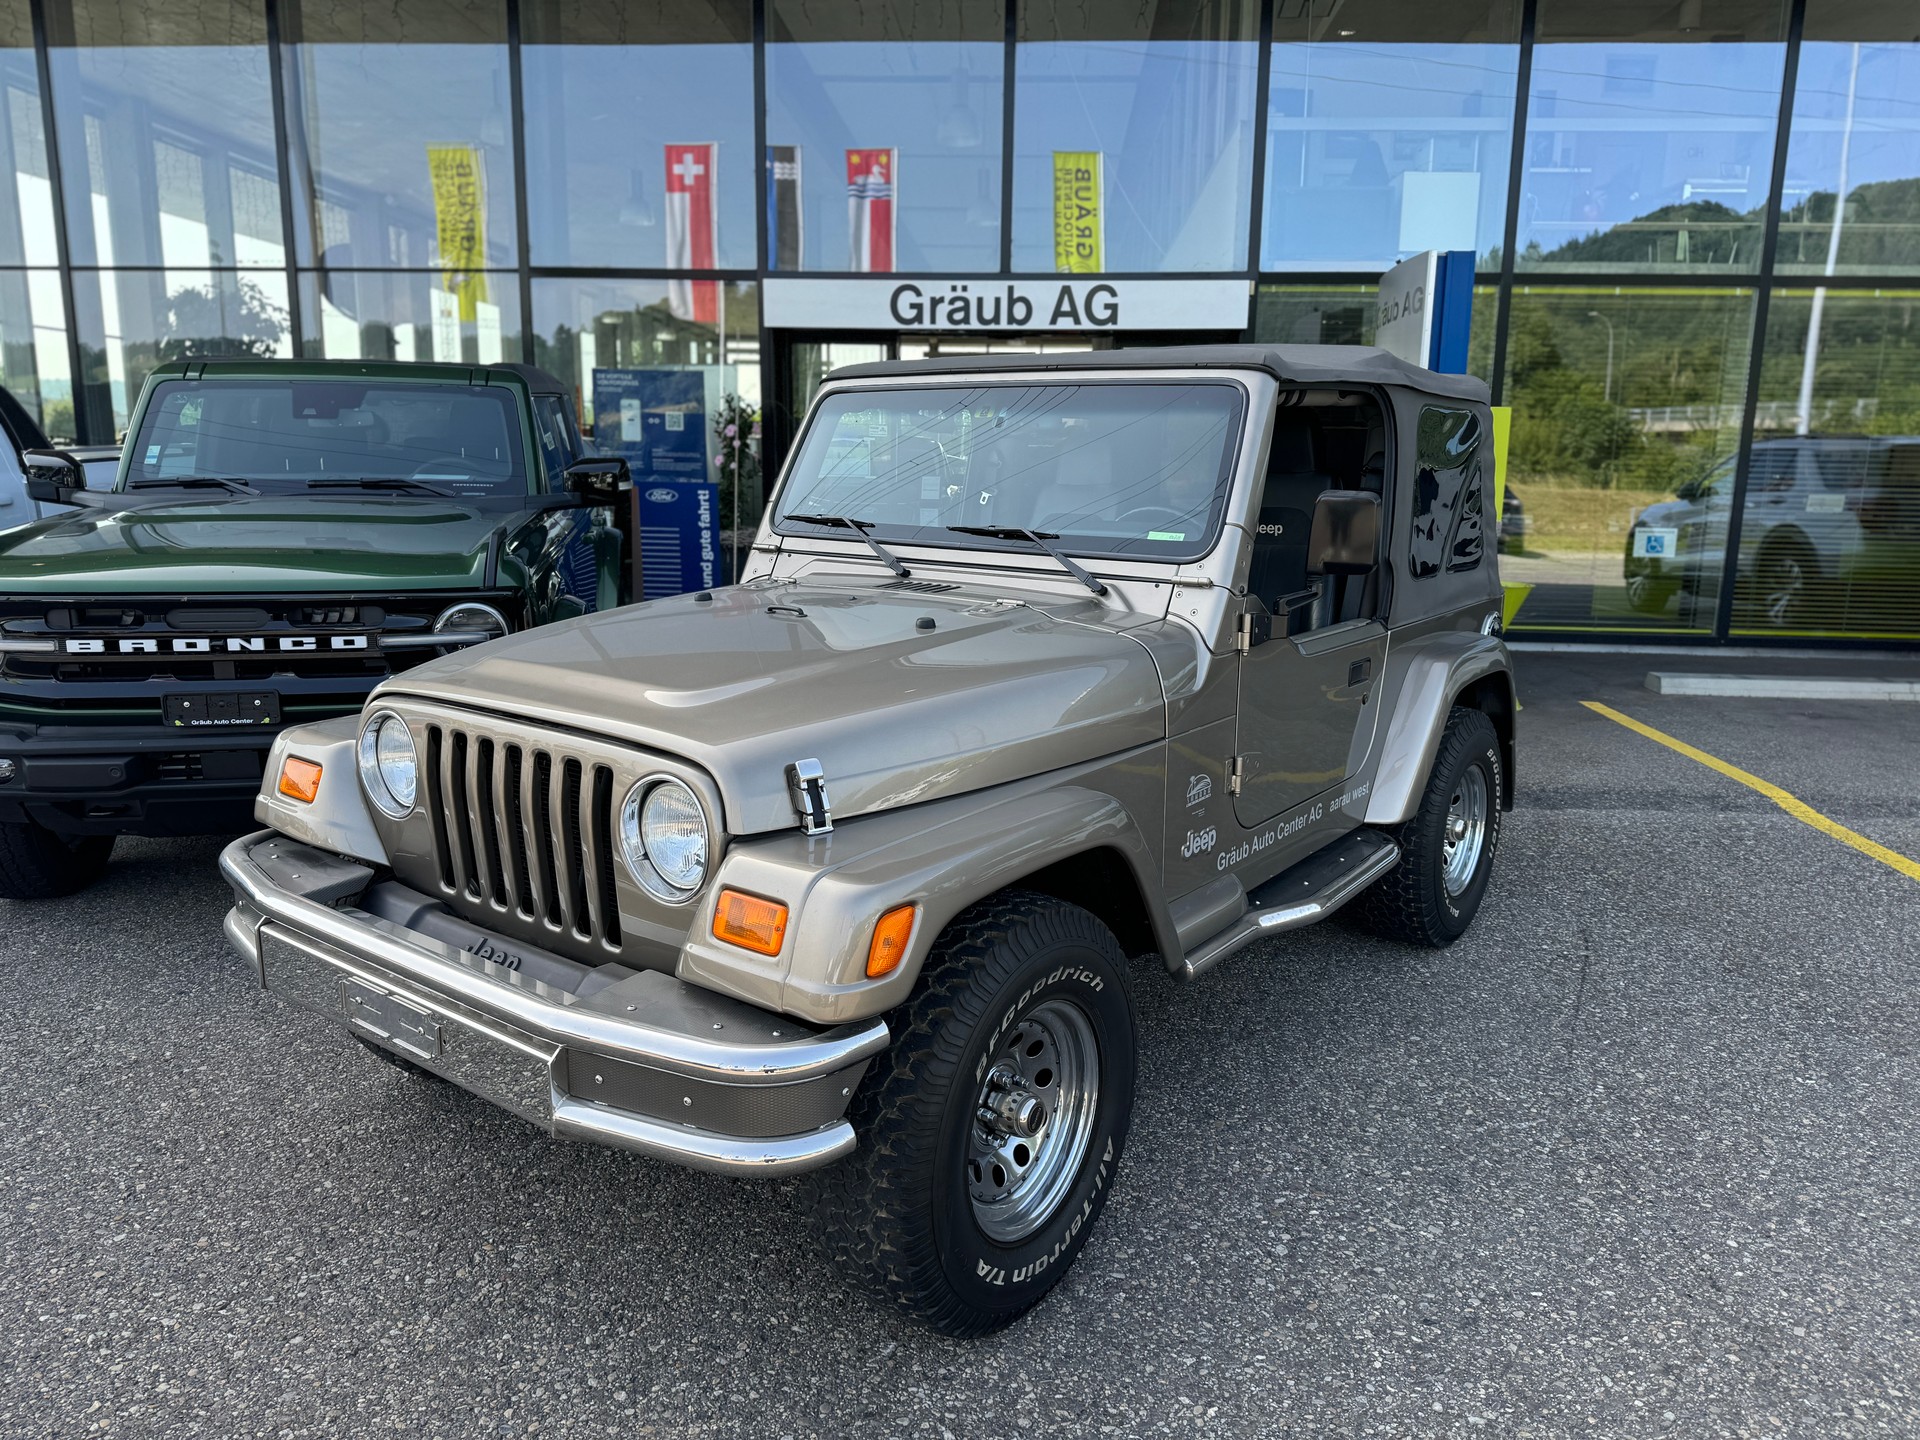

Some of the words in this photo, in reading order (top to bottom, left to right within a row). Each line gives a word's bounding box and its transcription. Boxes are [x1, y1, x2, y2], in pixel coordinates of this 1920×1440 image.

[890, 283, 1033, 326] Gräub
[1049, 284, 1119, 326] AG
[1402, 286, 1424, 318] AG
[697, 490, 711, 528] fahrt!
[700, 530, 714, 561] gute
[700, 562, 713, 588] und
[65, 636, 369, 653] BRONCO
[1217, 842, 1249, 871] Gräub
[1251, 831, 1275, 854] Auto
[1277, 814, 1307, 840] Center
[1308, 803, 1323, 824] AG
[1329, 792, 1351, 812] aarau
[1352, 780, 1370, 800] west
[1182, 827, 1217, 858] Jeep
[1012, 1136, 1114, 1283] All-Terrain
[976, 1259, 1006, 1286] T/A
